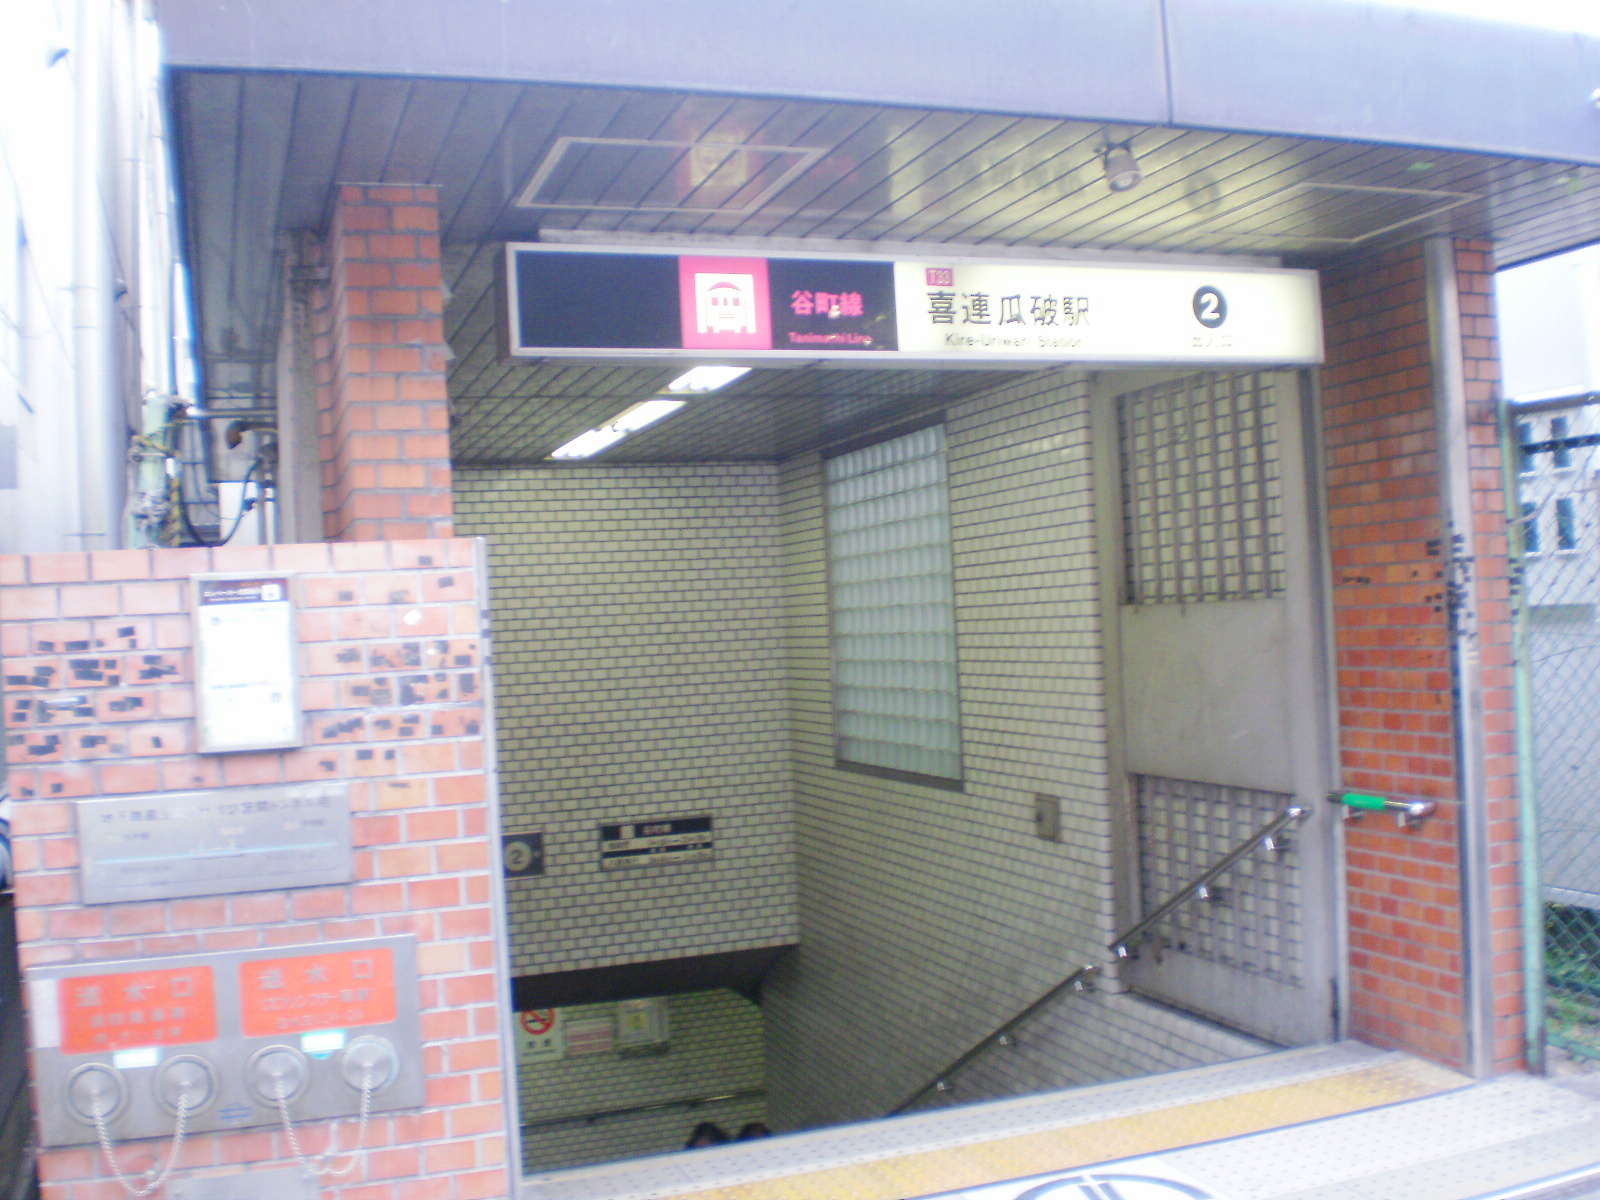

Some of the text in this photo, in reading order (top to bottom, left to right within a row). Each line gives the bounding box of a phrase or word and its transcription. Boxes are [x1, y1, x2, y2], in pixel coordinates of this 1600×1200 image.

[790, 289, 865, 317] 谷町線
[926, 290, 1090, 326] 喜連瓜破駅
